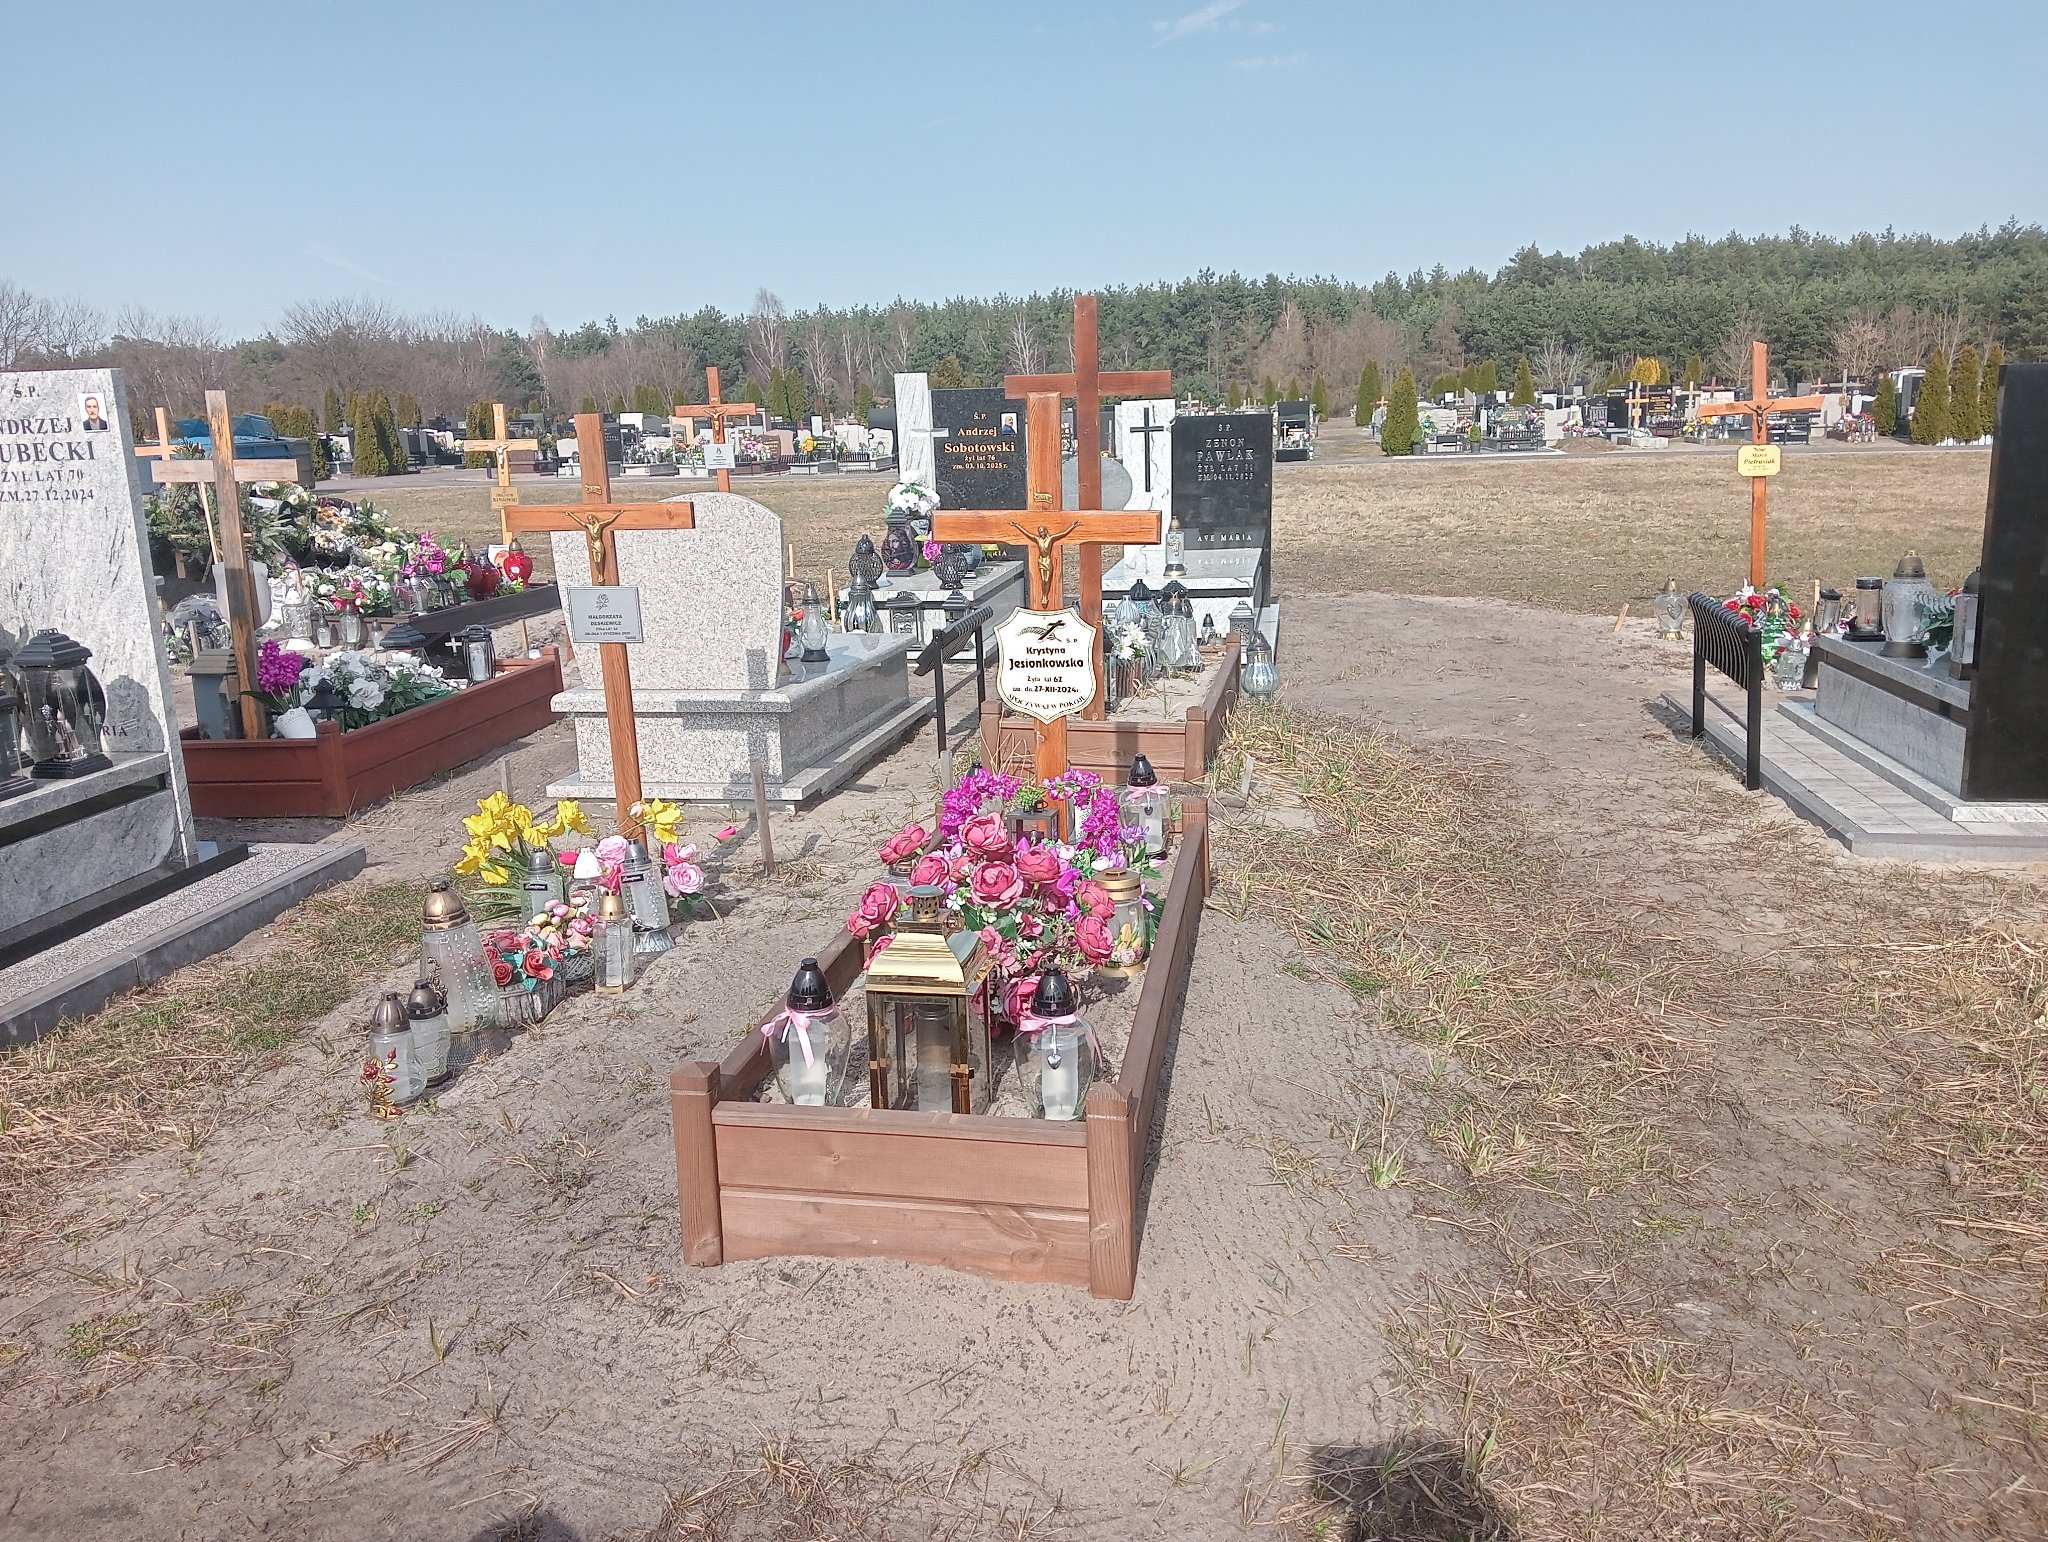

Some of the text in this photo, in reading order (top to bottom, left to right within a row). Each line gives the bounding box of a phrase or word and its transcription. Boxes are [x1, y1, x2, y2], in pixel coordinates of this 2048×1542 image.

[957, 427, 998, 437] Andrzej
[944, 442, 1015, 453] Sobotowski
[1205, 438, 1244, 448] ZENON
[0, 441, 96, 463] UBECKI
[1196, 449, 1254, 462] PAWLAK
[36, 470, 63, 482] LAT
[1220, 534, 1252, 542] MARIA
[1026, 647, 1066, 656] Krystyna
[1009, 658, 1084, 670] Jesionkowska
